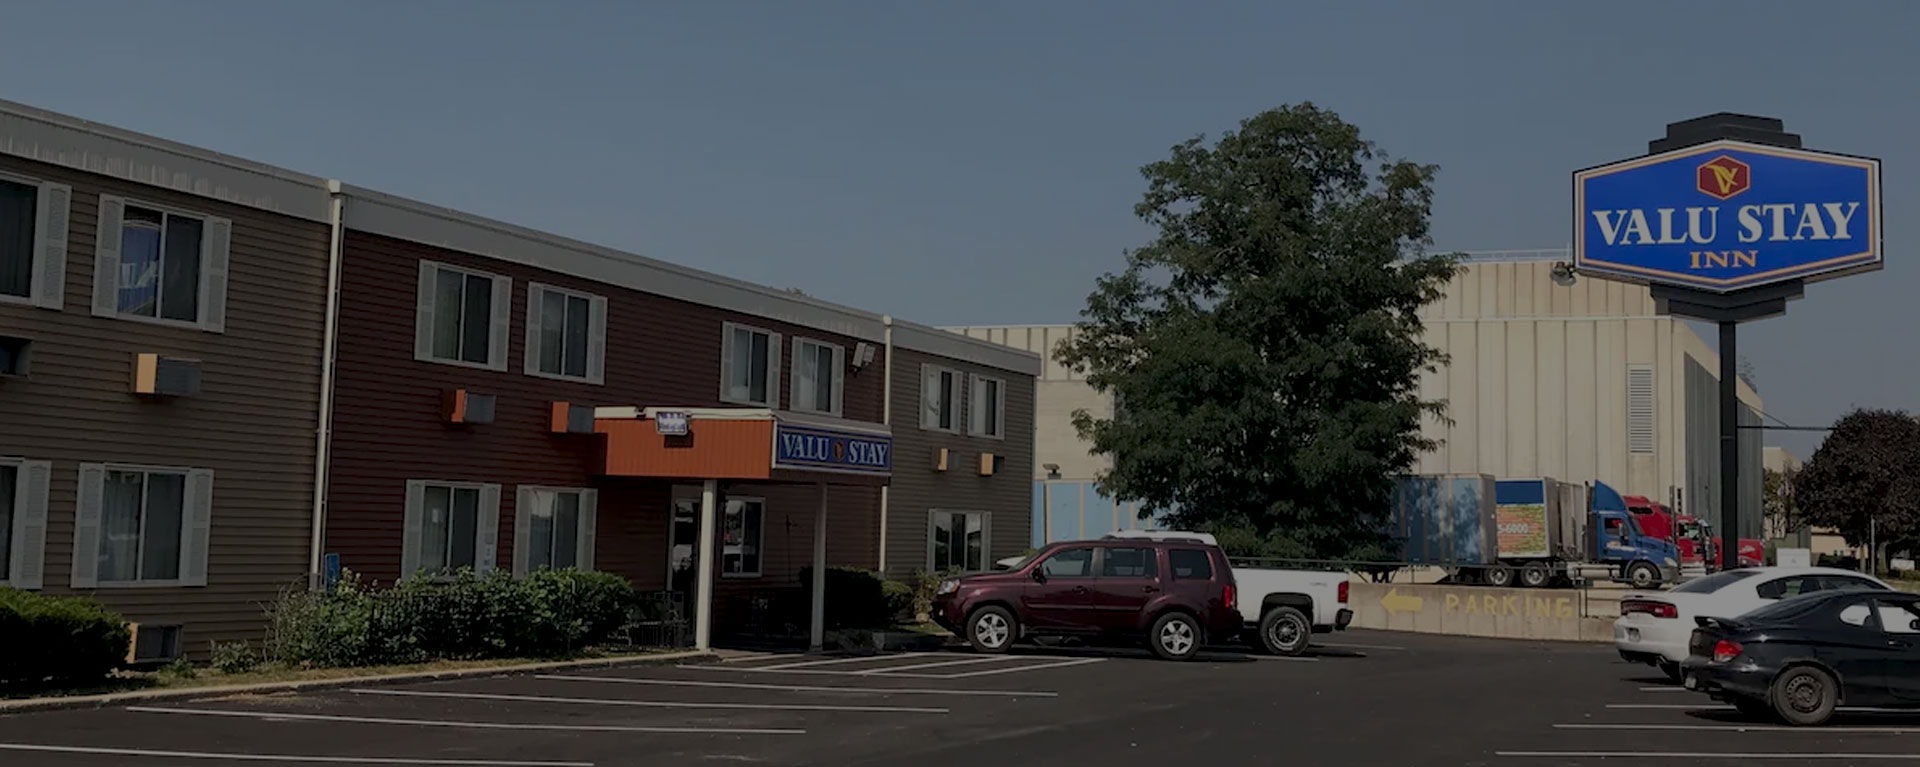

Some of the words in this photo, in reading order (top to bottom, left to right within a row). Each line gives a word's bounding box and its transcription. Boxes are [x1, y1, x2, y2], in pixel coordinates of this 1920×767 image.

[1592, 207, 1719, 245] VALU
[1738, 202, 1860, 243] STAY
[1690, 250, 1759, 269] INN
[782, 433, 829, 460] VALU
[849, 440, 888, 465] STAY
[1446, 593, 1573, 618] PARKING
